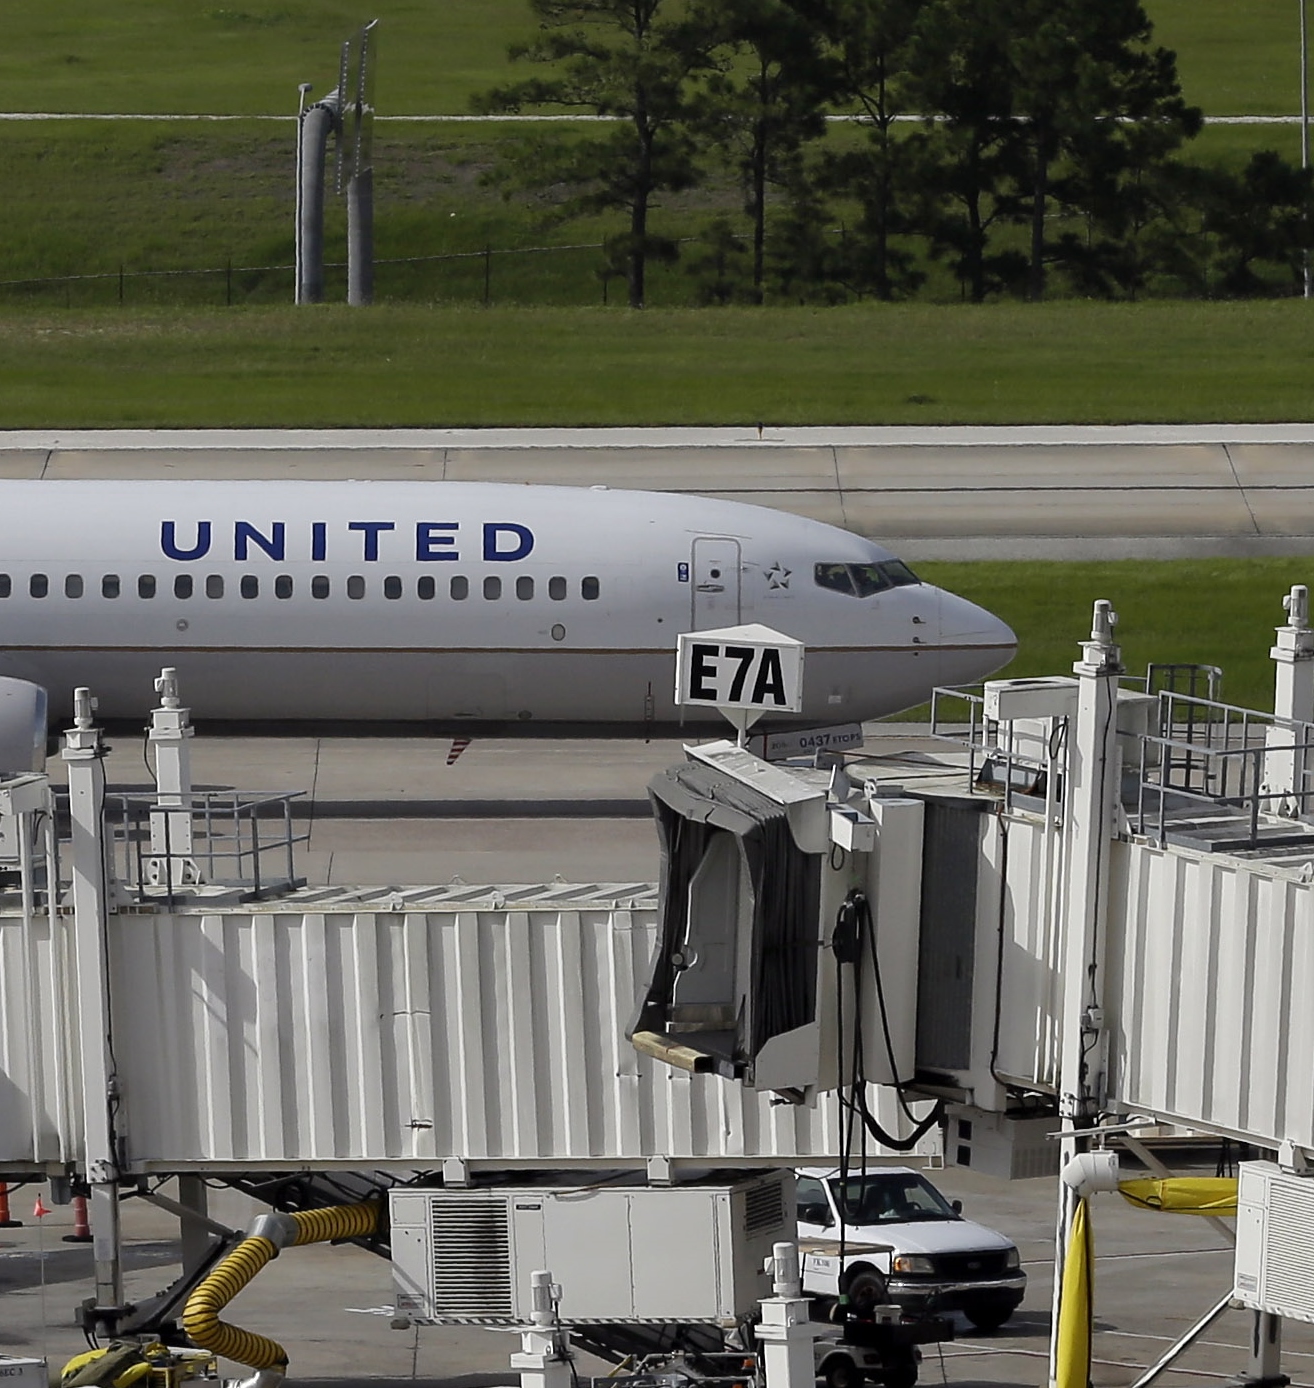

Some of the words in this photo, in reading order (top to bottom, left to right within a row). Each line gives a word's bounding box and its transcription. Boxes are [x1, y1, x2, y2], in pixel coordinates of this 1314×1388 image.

[160, 520, 535, 562] UNITED
[689, 643, 787, 706] E7A
[799, 733, 831, 748] 0437
